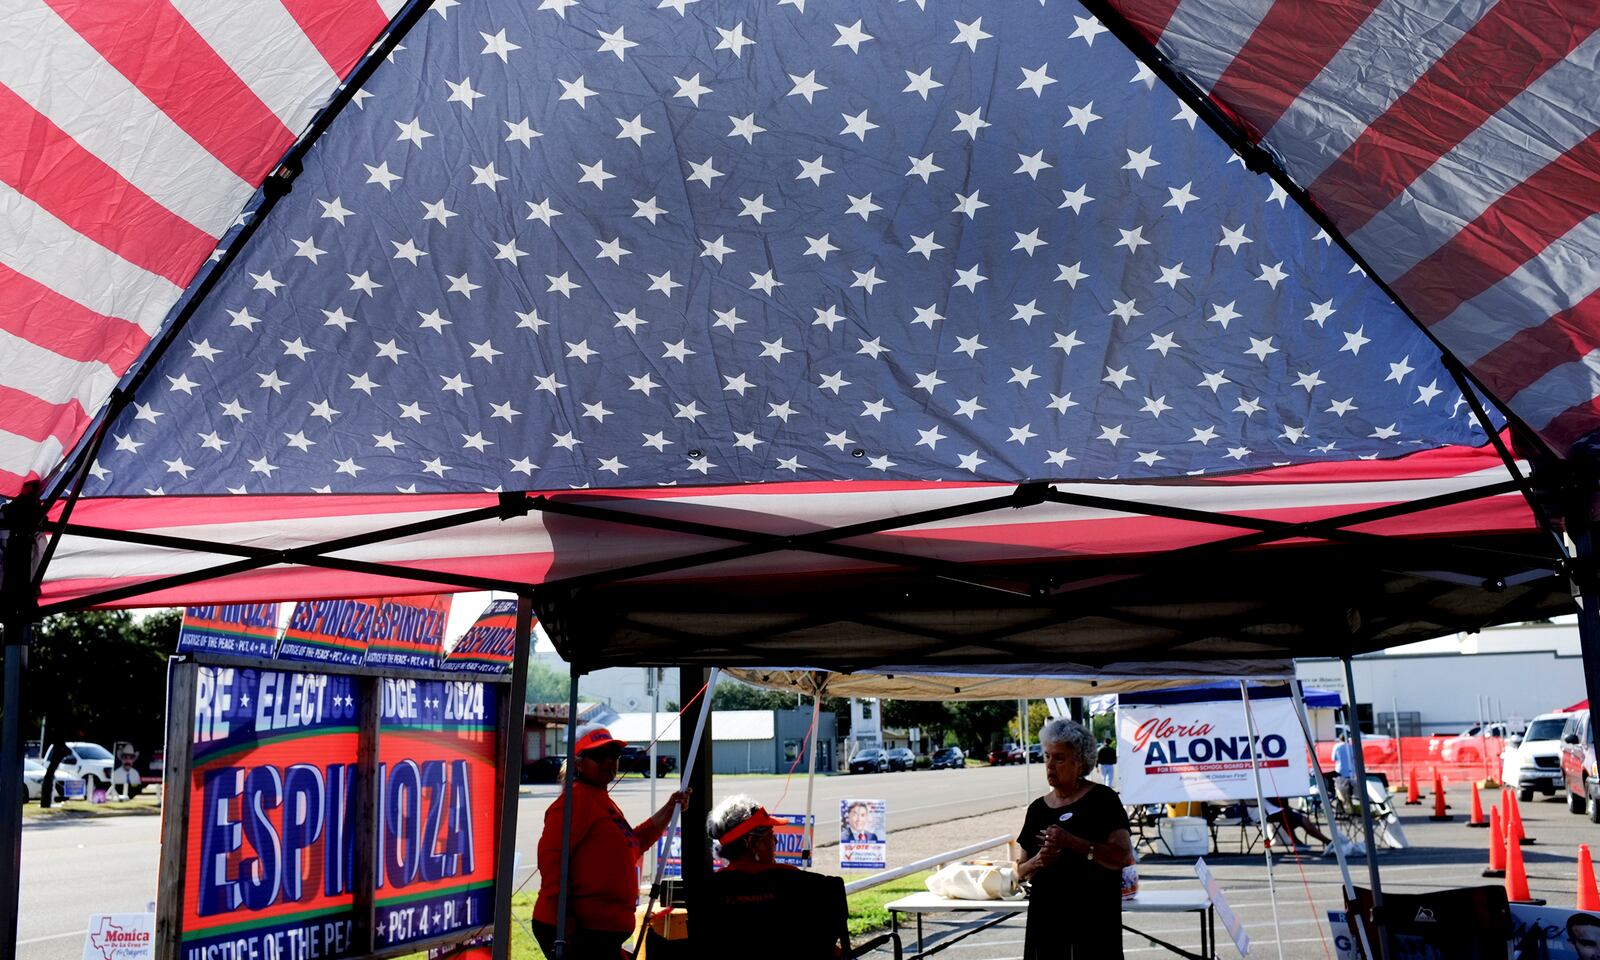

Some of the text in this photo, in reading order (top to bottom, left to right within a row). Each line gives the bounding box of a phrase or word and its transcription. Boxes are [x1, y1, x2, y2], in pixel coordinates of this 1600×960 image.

[289, 600, 377, 642] ESPINOZA
[372, 602, 446, 646] ESPINOZA
[182, 633, 200, 646] JUSTICE
[200, 635, 207, 647] OF
[207, 636, 218, 648] THE
[218, 637, 235, 650] PEACE
[238, 640, 249, 652] PCT.
[250, 642, 255, 652] 4
[259, 643, 268, 655] PL.
[281, 643, 299, 656] JUSTICE
[298, 645, 305, 656] OF
[305, 647, 314, 658] THE
[313, 648, 330, 660] PEACE
[452, 626, 516, 656] ESPINOZ
[193, 667, 484, 744] RE ELECT DGE 2024
[1132, 717, 1215, 753] Gloria
[1144, 734, 1287, 765] ALONZO
[104, 928, 150, 942] Monica
[263, 931, 285, 960] OF
[287, 925, 320, 960] THE
[325, 919, 353, 955] PEA
[388, 905, 416, 943] PCT.
[419, 905, 429, 935] 4
[444, 900, 462, 931] PL.
[465, 897, 472, 925] 1
